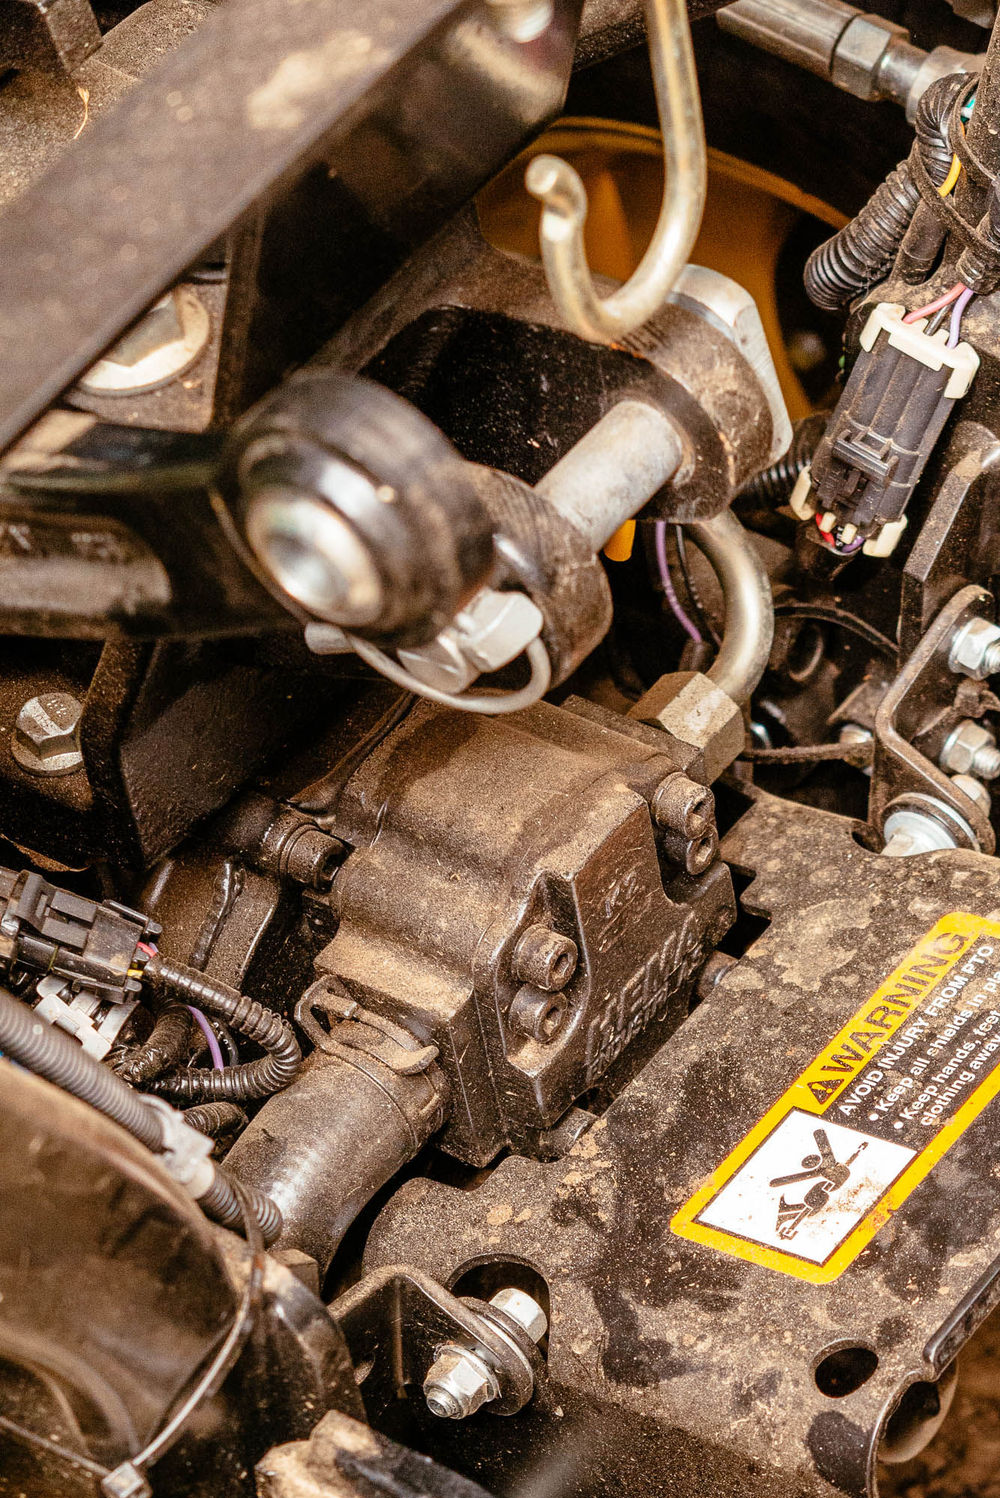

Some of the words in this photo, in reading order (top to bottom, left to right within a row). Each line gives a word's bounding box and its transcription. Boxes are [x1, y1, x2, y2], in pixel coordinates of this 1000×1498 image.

[821, 932, 969, 1073] WARNING
[838, 1070, 884, 1116] AVOID
[877, 1016, 930, 1069] INJURY
[924, 974, 969, 1017] FROM
[961, 945, 994, 975] PTO
[875, 1076, 914, 1112] Keep
[909, 1057, 931, 1076] all
[926, 1009, 974, 1057] shields
[966, 993, 988, 1008] in
[899, 1084, 939, 1120] Keep
[931, 1040, 982, 1083] hands,
[920, 1070, 976, 1126] clothing
